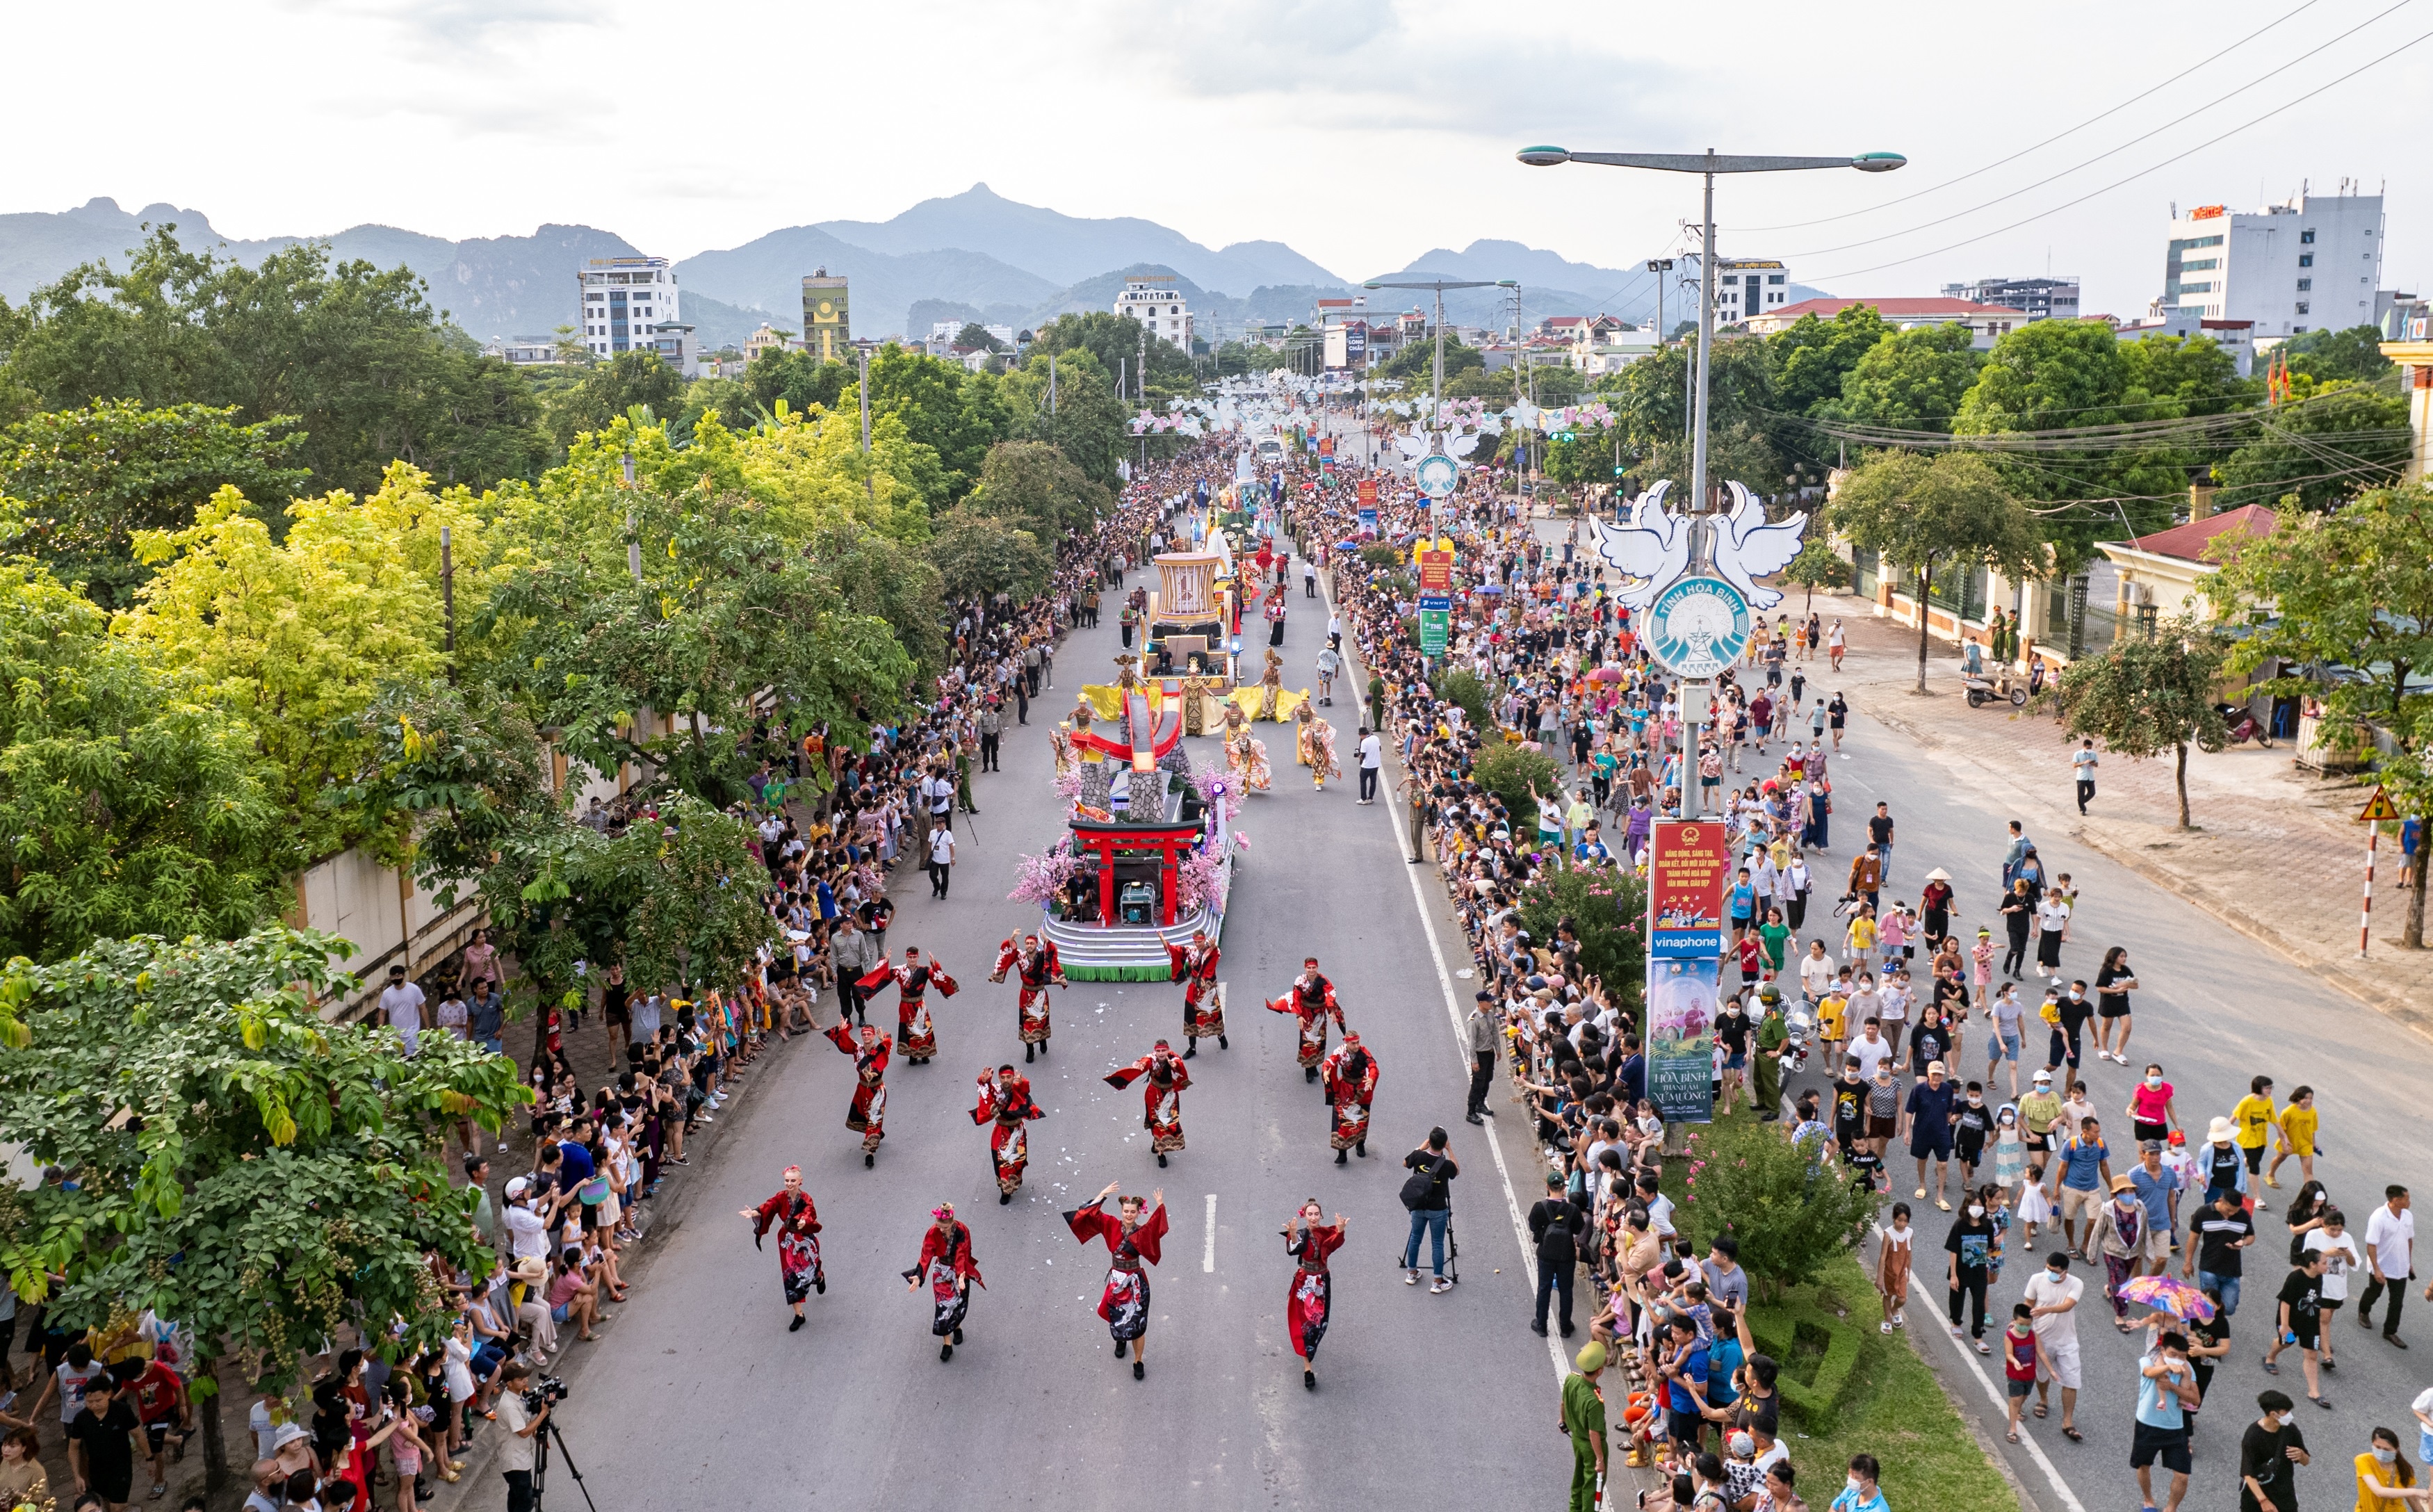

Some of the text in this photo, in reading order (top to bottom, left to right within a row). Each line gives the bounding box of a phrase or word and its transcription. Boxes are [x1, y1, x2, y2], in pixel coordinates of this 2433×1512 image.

[1686, 580, 1714, 596] HÒA
[1715, 587, 1741, 612] BÌNH
[1453, 713, 1458, 723] 2
[1655, 936, 1718, 949] vinaphone
[1654, 1071, 1708, 1084] HÒA BÌNH
